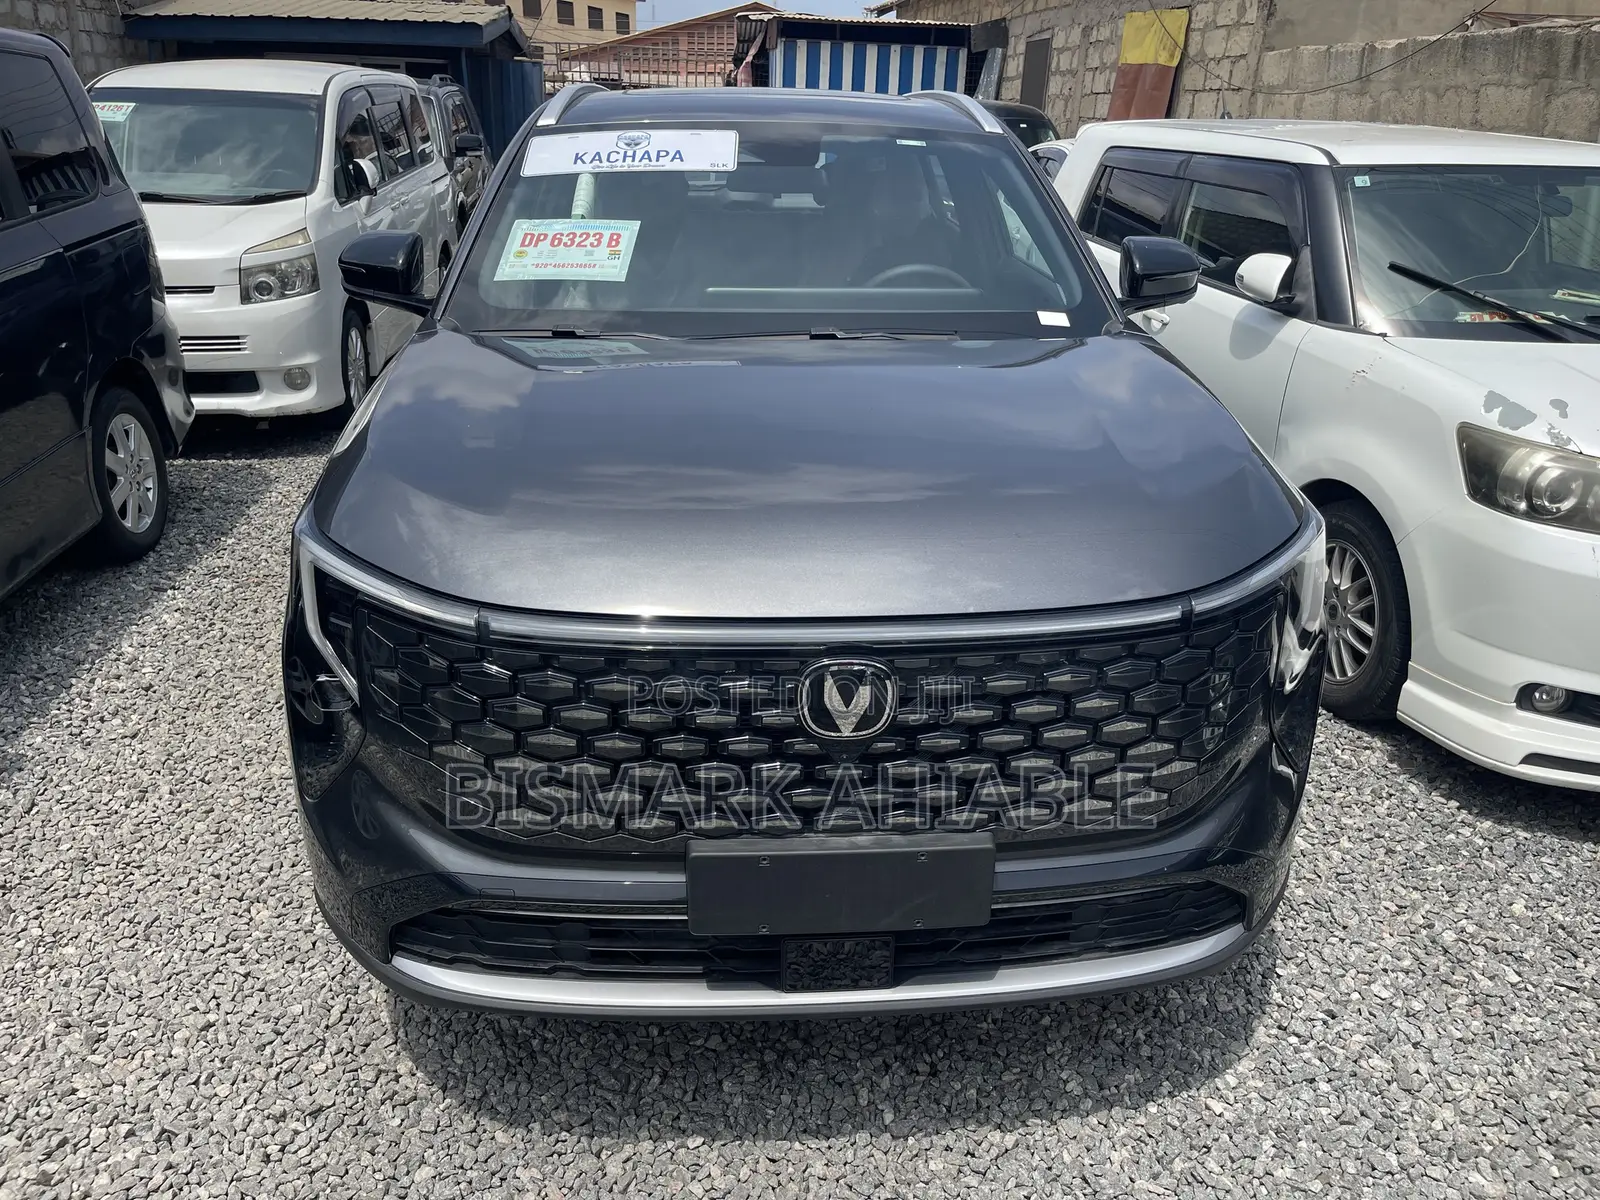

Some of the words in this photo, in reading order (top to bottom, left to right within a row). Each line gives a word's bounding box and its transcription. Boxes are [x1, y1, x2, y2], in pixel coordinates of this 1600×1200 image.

[573, 149, 685, 165] KACHAPA
[519, 232, 549, 248] DP
[549, 231, 604, 249] 6323
[606, 232, 622, 249] B
